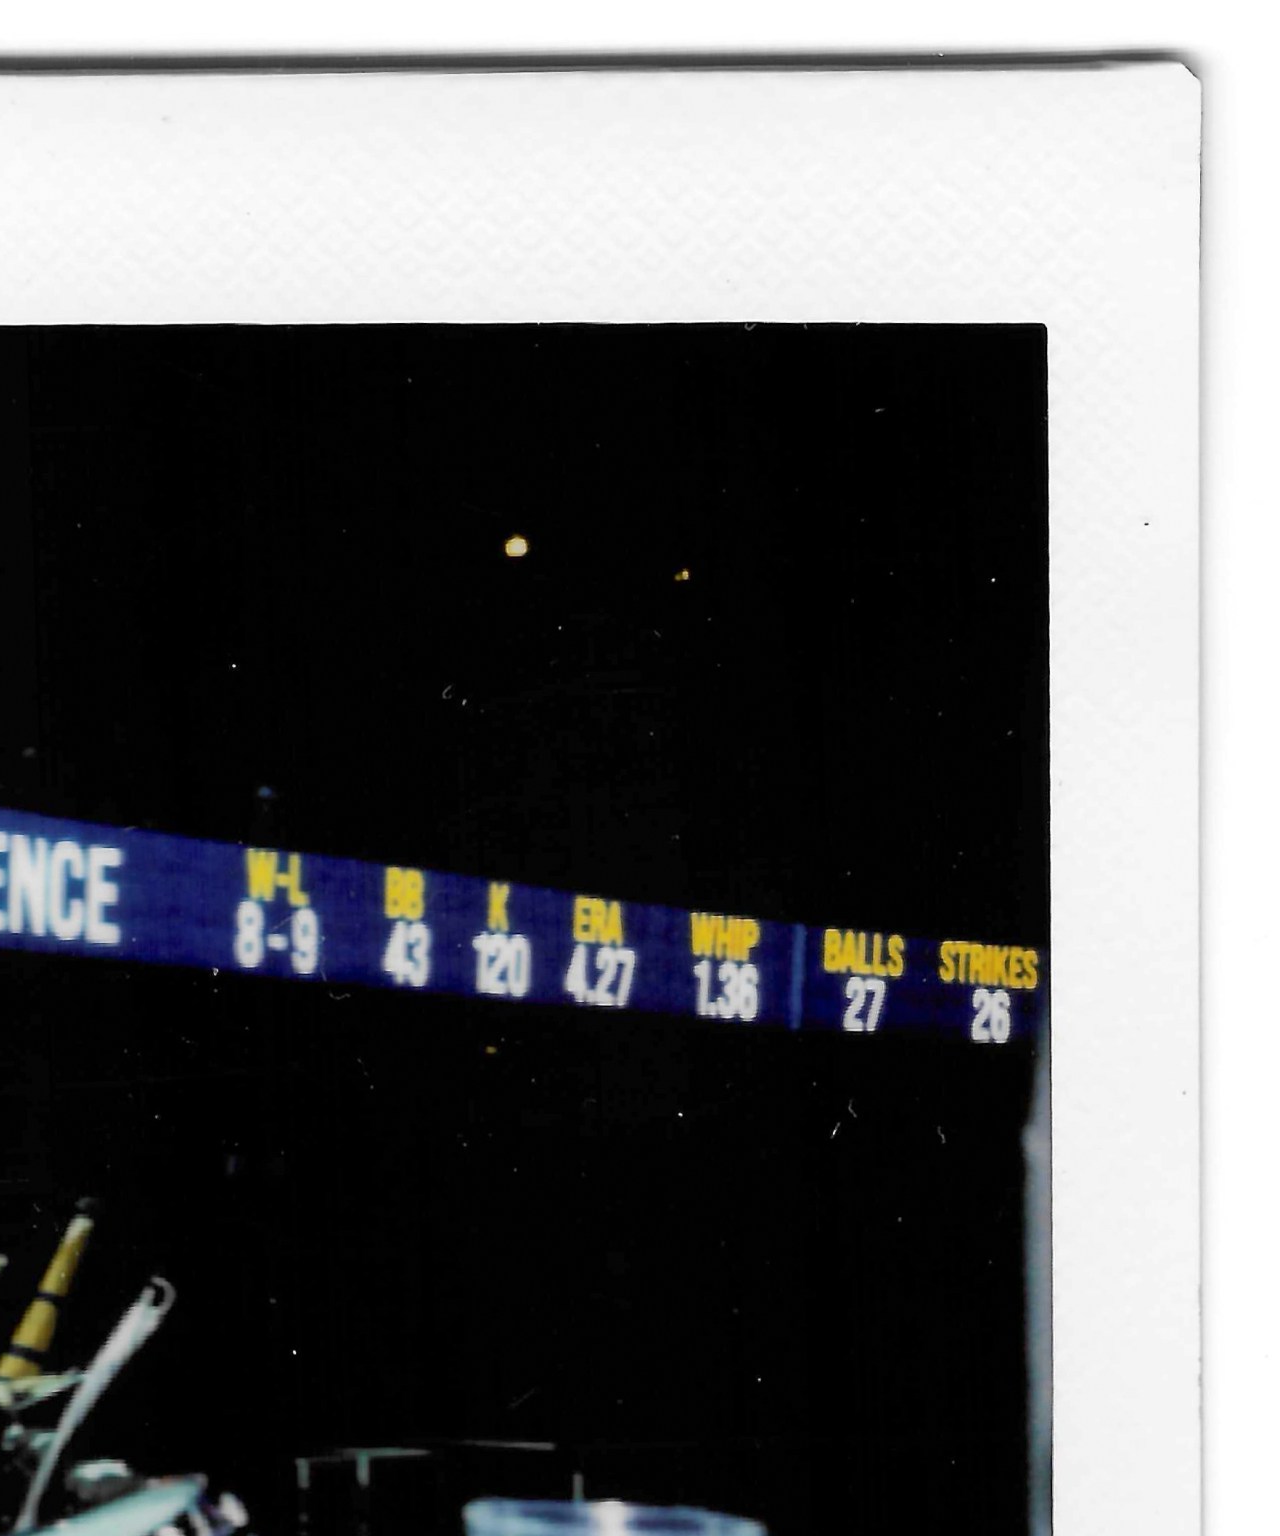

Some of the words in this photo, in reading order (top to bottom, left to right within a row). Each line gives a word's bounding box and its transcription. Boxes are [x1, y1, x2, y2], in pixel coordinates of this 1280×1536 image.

[246, 848, 309, 907] W-L
[384, 866, 424, 920] BB
[487, 882, 510, 932] K
[572, 895, 624, 945] ERA
[690, 912, 760, 961] WHIP
[234, 900, 319, 976] 8-9
[383, 920, 431, 987] 43
[472, 932, 532, 998] 120
[564, 942, 636, 1008] 4.27
[693, 960, 760, 1022] 1.36
[823, 928, 905, 978] BALLS
[939, 939, 1039, 990] STRIKES
[843, 976, 887, 1033] 27
[970, 987, 1011, 1045] 26
